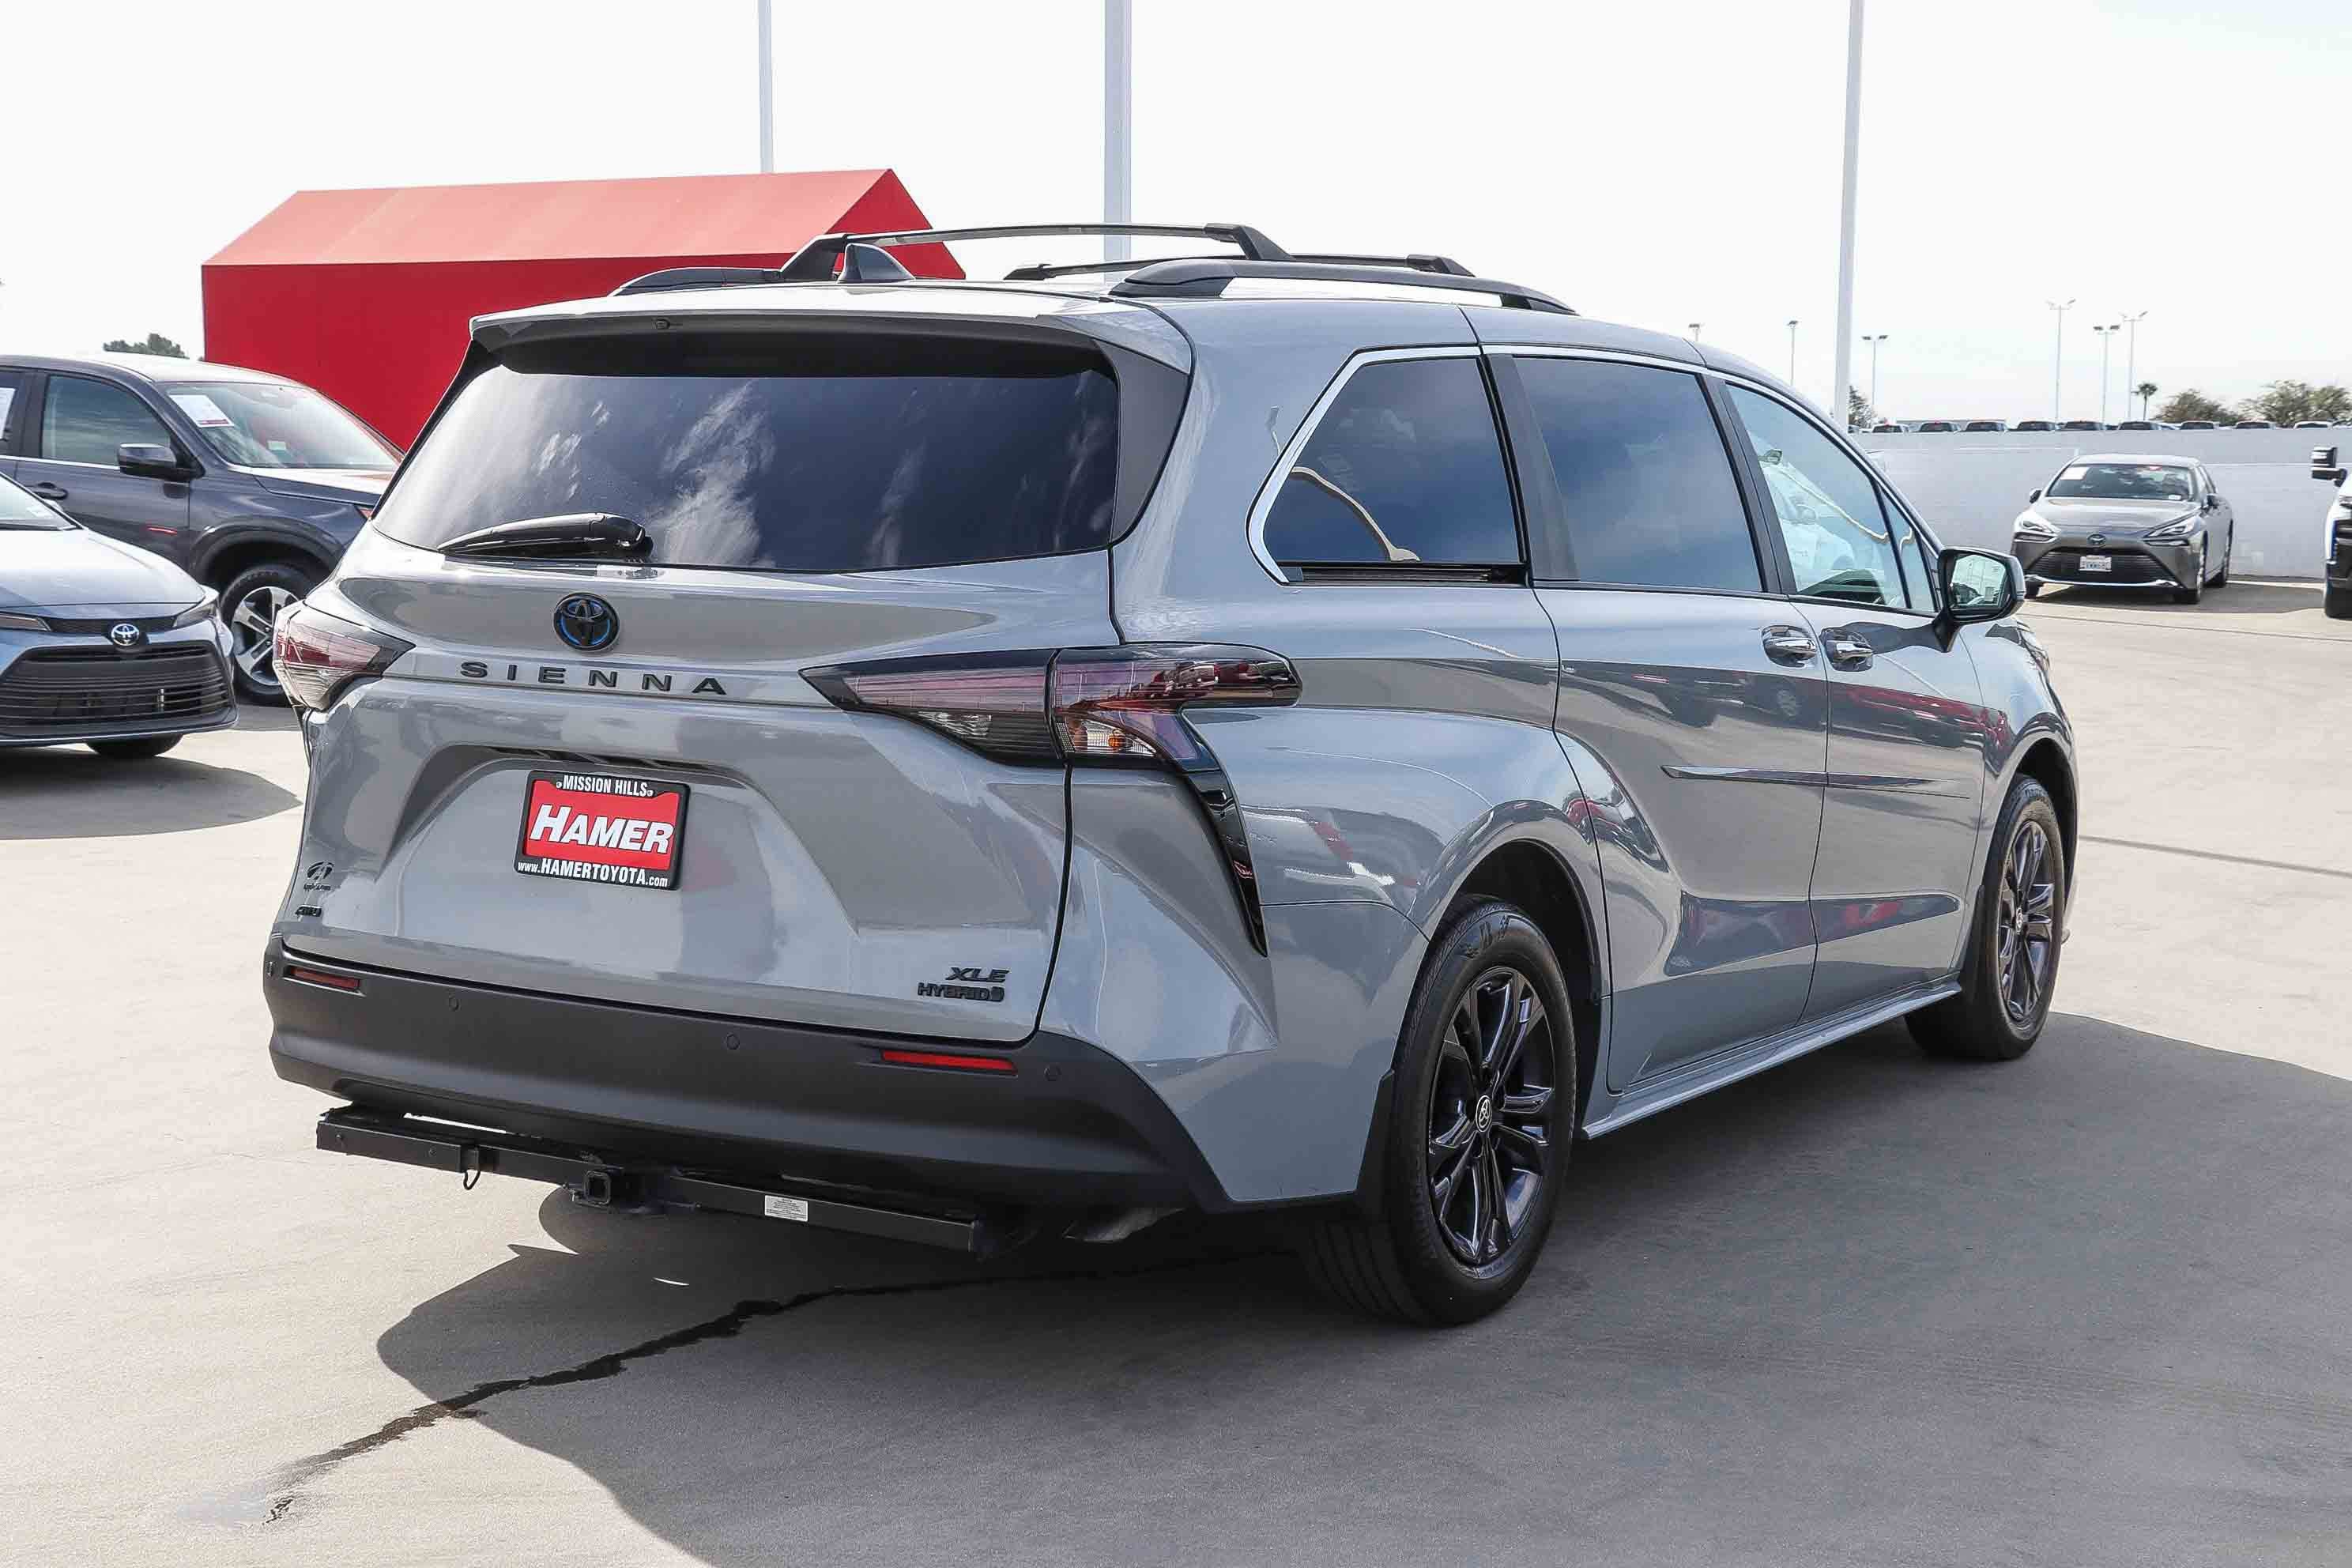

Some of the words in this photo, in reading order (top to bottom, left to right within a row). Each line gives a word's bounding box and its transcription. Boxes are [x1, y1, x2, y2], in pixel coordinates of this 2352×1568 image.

[460, 661, 727, 695] SIENNA
[563, 775, 612, 793] MISSION
[615, 779, 648, 797] HILLS
[529, 803, 675, 854] HAMER
[517, 858, 668, 888] www.HAMERTOYOTA.com
[945, 967, 1010, 983] XLE
